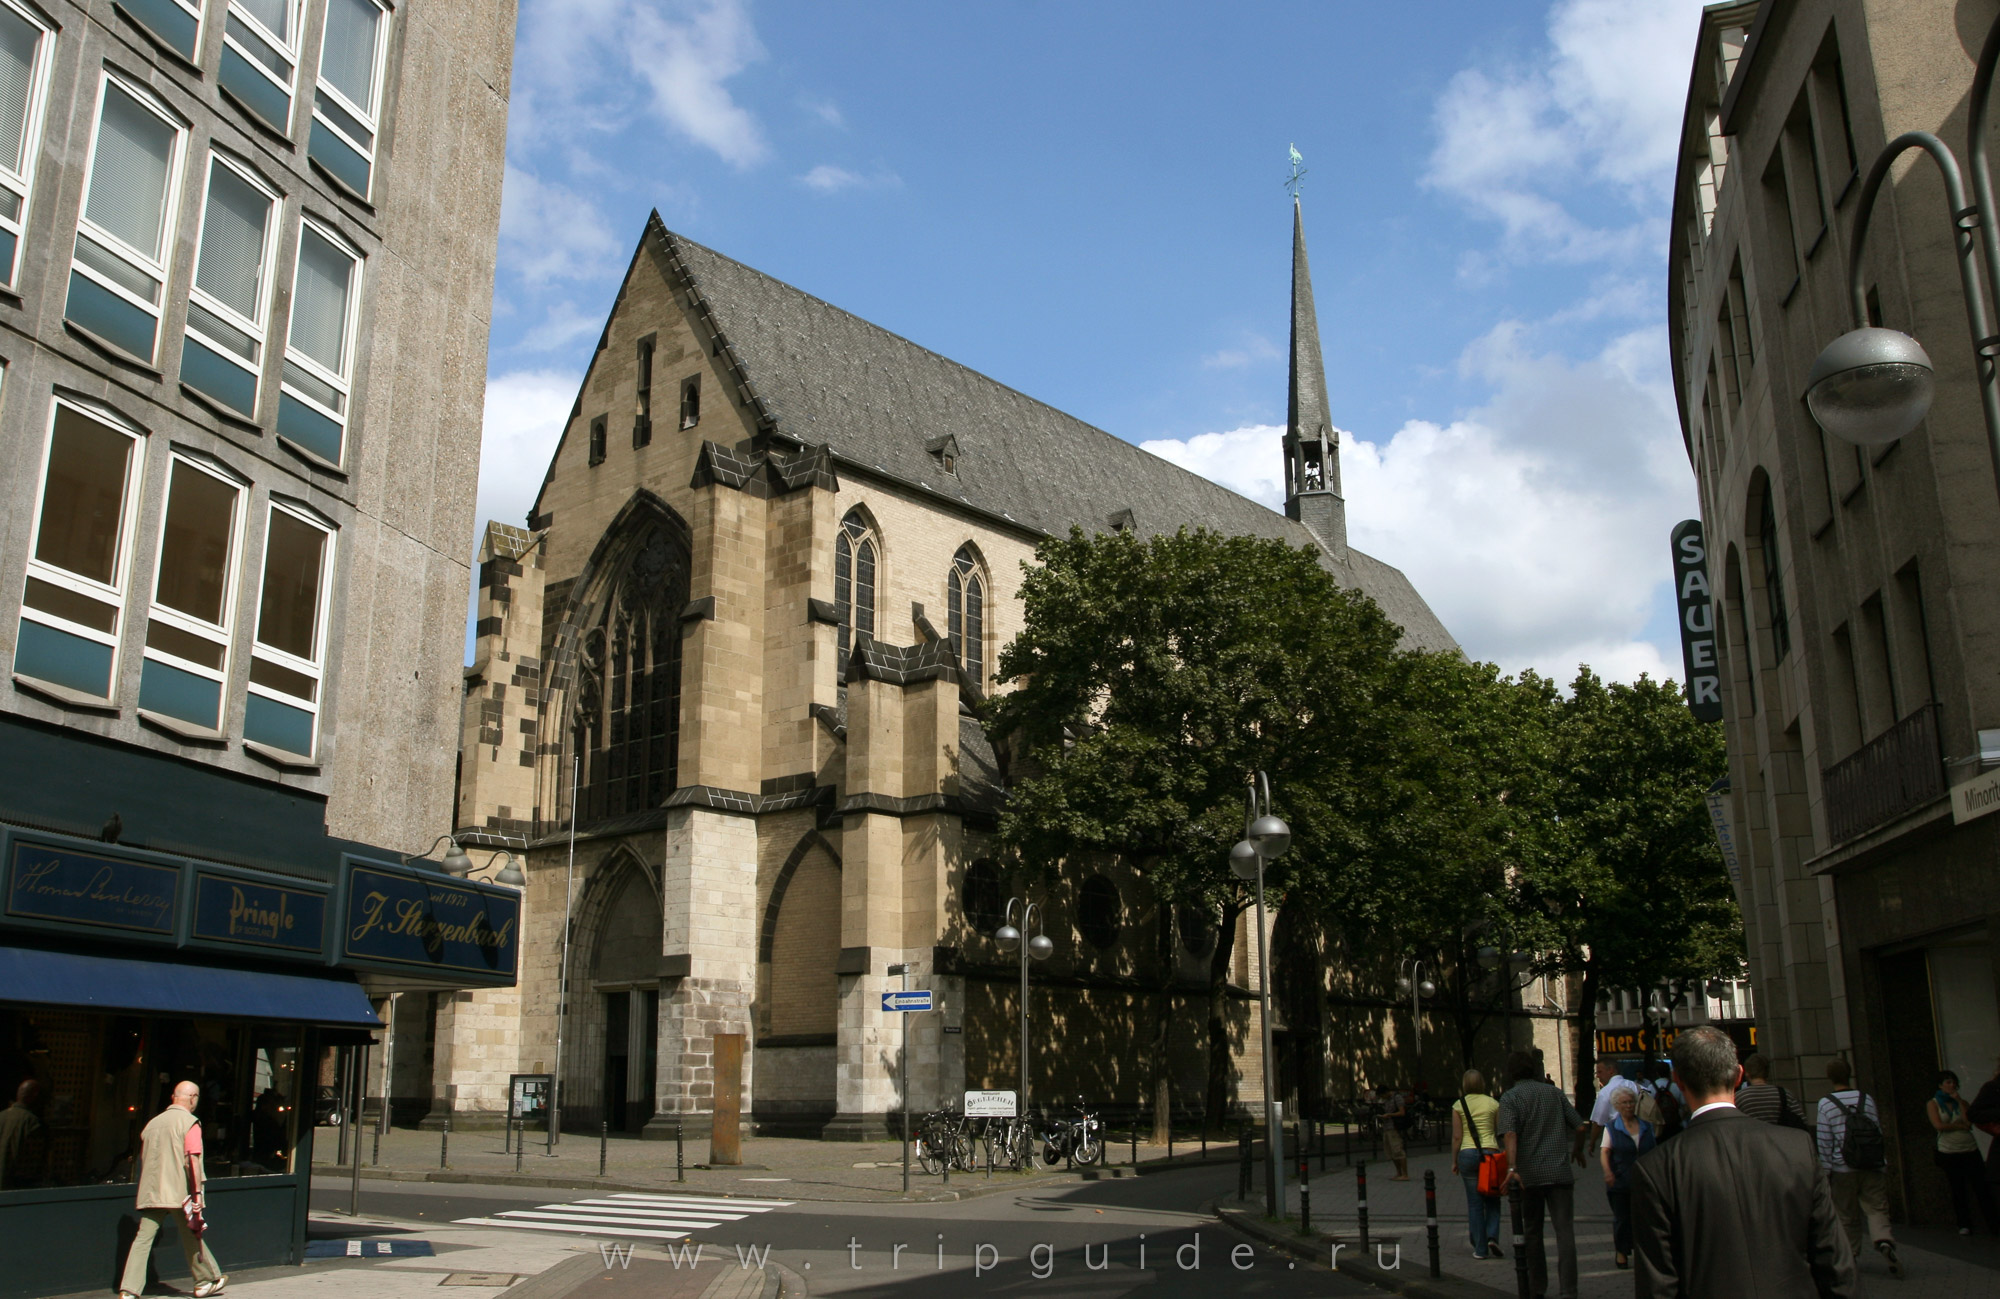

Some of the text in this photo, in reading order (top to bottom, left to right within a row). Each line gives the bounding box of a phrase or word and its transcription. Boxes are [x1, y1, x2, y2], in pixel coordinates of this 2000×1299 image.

[1680, 535, 1720, 705] SAUER
[1964, 779, 2000, 813] Minorit
[16, 859, 86, 898] Thomas
[229, 885, 295, 939] Pringle
[387, 899, 513, 953] Sterzenbach
